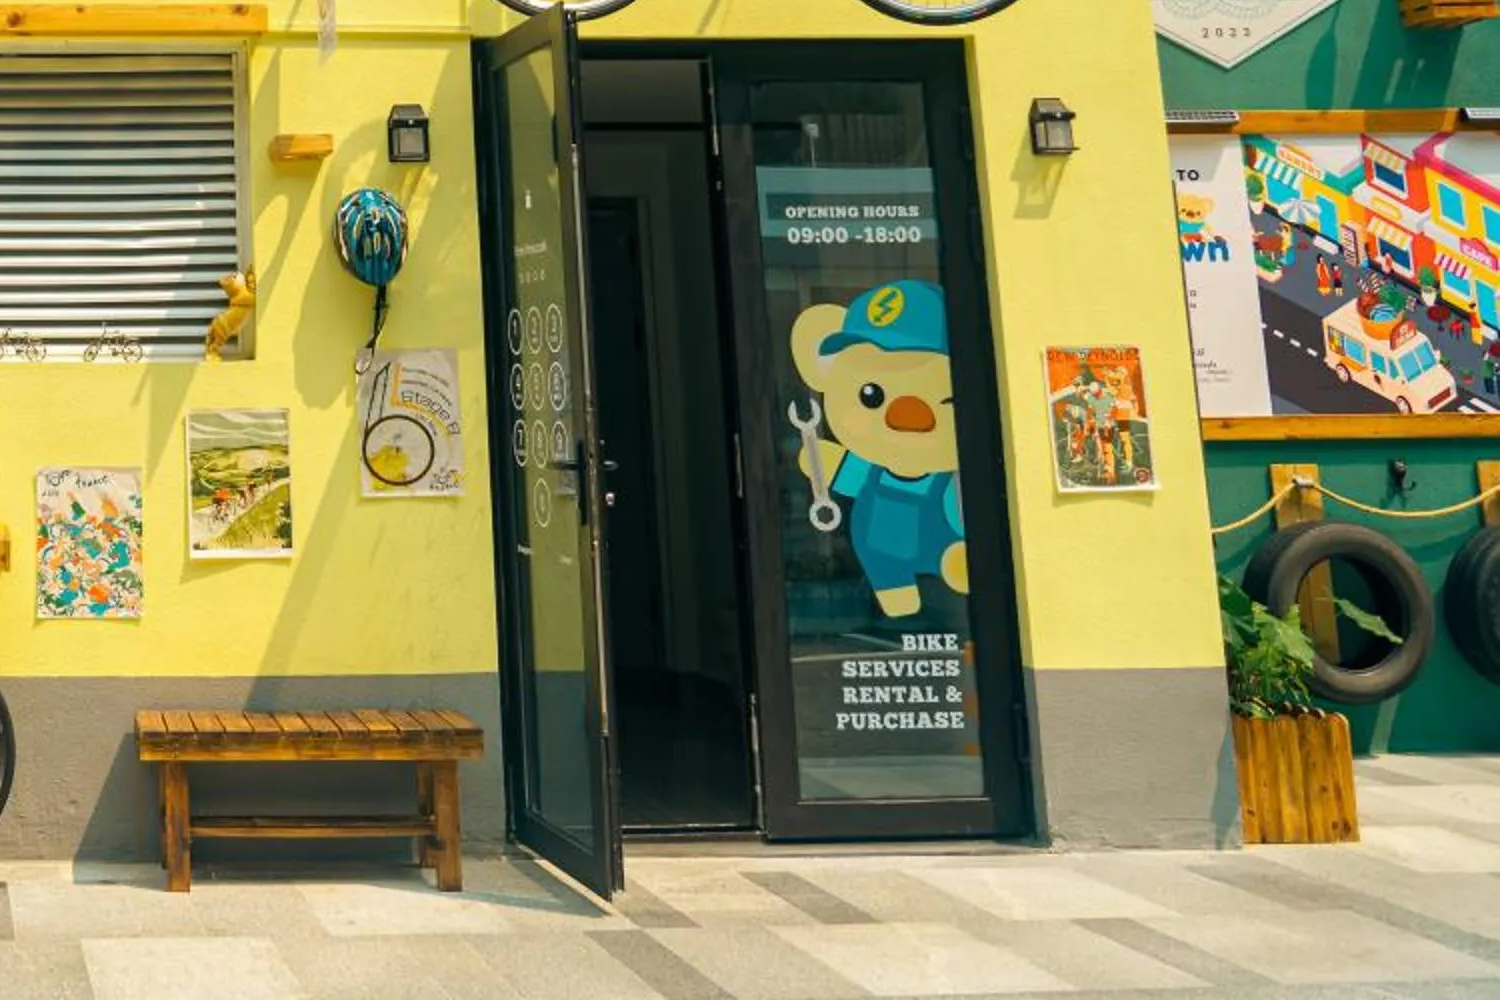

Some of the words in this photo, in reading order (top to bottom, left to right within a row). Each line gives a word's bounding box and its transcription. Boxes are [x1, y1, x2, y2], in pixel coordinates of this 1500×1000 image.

[1175, 169, 1200, 181] TO
[785, 205, 859, 219] OPENING
[863, 204, 920, 218] HOURS
[787, 226, 849, 244] 09:00
[901, 633, 959, 651] BIKE
[841, 660, 961, 678] SERVICES
[842, 685, 939, 704] RENTAL
[945, 685, 963, 703] &
[835, 711, 965, 731] PURCHASE
